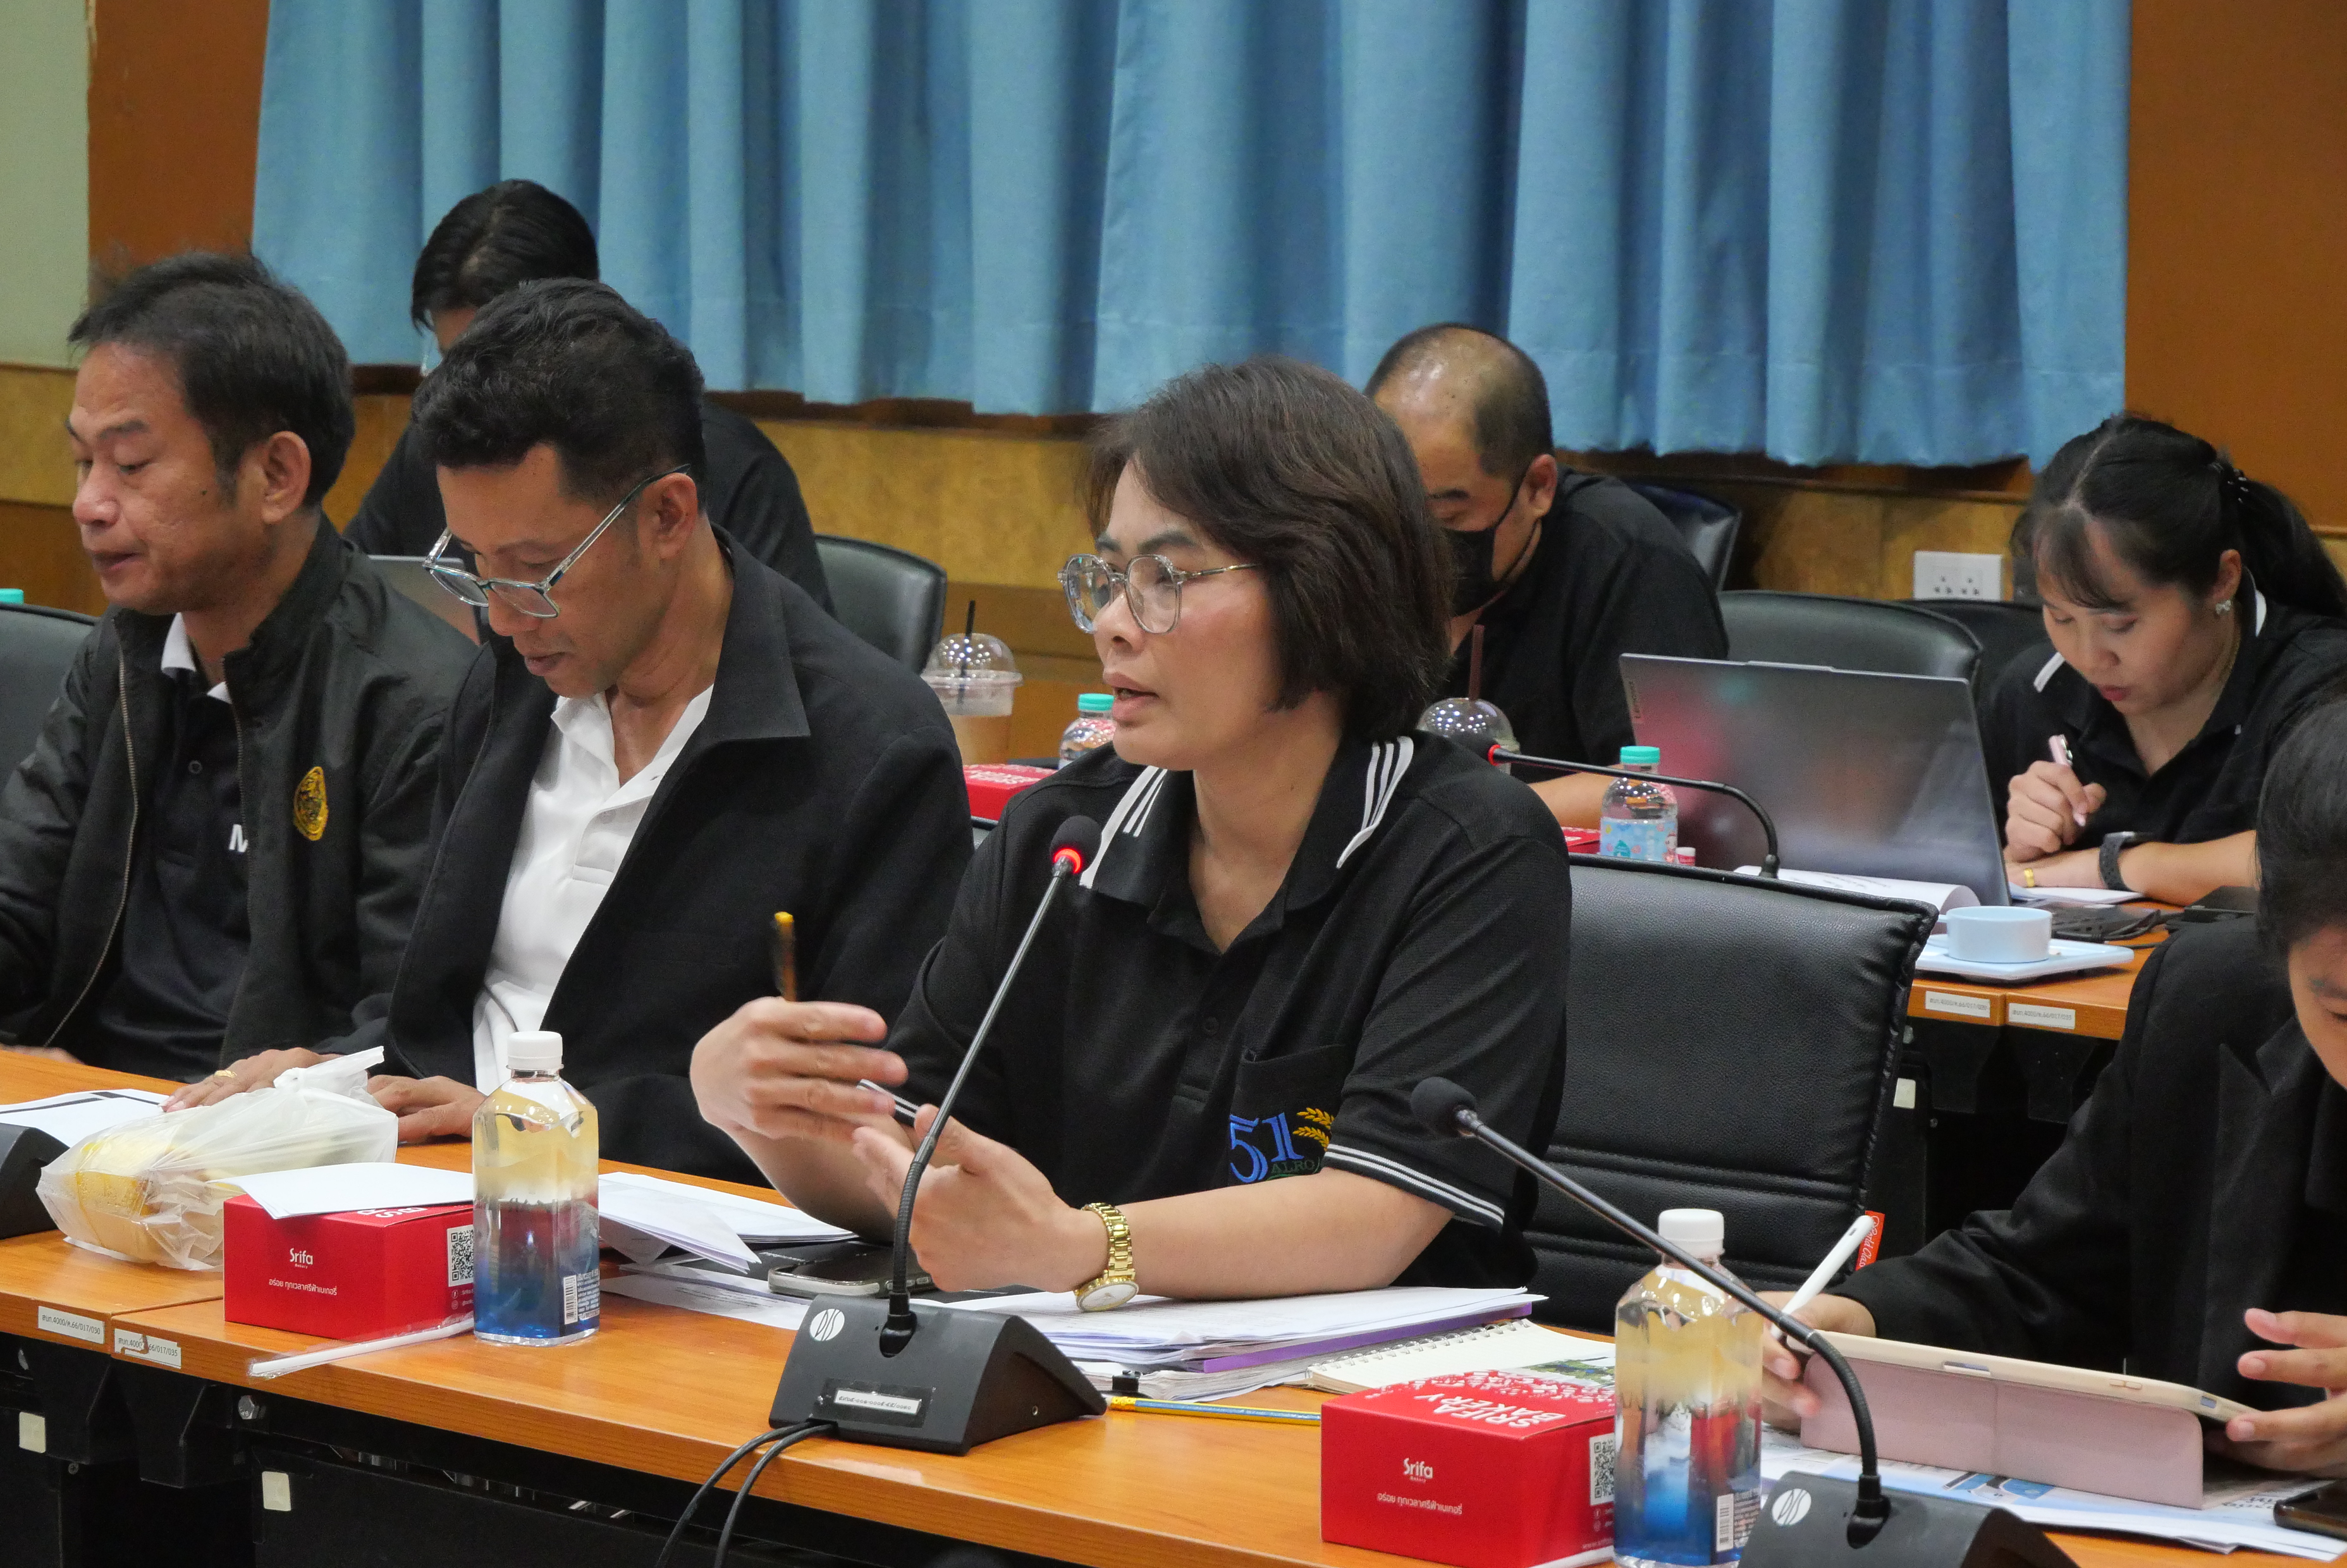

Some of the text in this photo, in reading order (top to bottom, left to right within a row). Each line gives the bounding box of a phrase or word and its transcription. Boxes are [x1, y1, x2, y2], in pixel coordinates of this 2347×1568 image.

[1229, 1112, 1304, 1183] 51
[290, 1247, 314, 1265] Srifa
[269, 1278, 283, 1287] อร่อย
[1413, 1392, 1566, 1423] BAKERY
[1433, 1403, 1540, 1428] SRIFA
[1403, 1457, 1433, 1479] Srifa
